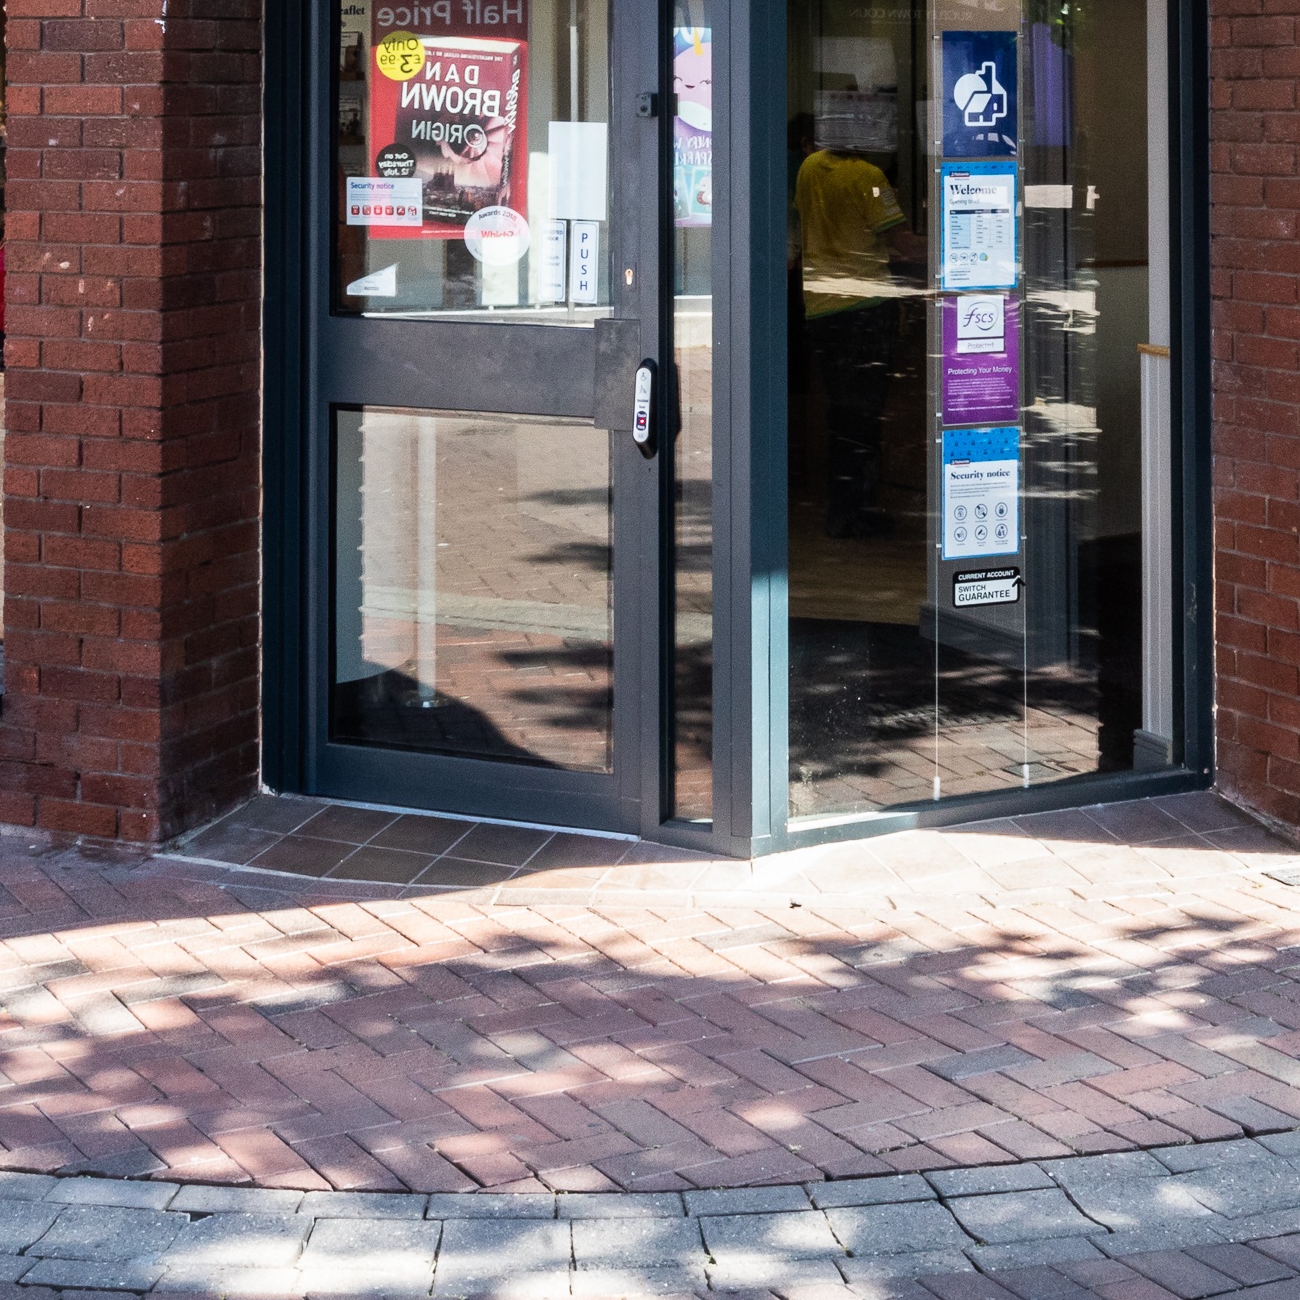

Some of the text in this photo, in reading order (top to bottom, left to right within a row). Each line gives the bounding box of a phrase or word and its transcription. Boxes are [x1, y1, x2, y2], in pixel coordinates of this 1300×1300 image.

[350, 182, 375, 190] Security
[950, 184, 997, 195] Welcome
[478, 209, 501, 221] Awards
[579, 232, 589, 292] PUSH
[967, 341, 994, 350] Protected
[948, 366, 1012, 375] Protecting Your Money
[950, 469, 1010, 481] Security notice
[958, 569, 1014, 581] CURRENT ACCOUNT
[958, 585, 986, 593] SWITCH
[958, 590, 1010, 602] GUARANTEE
